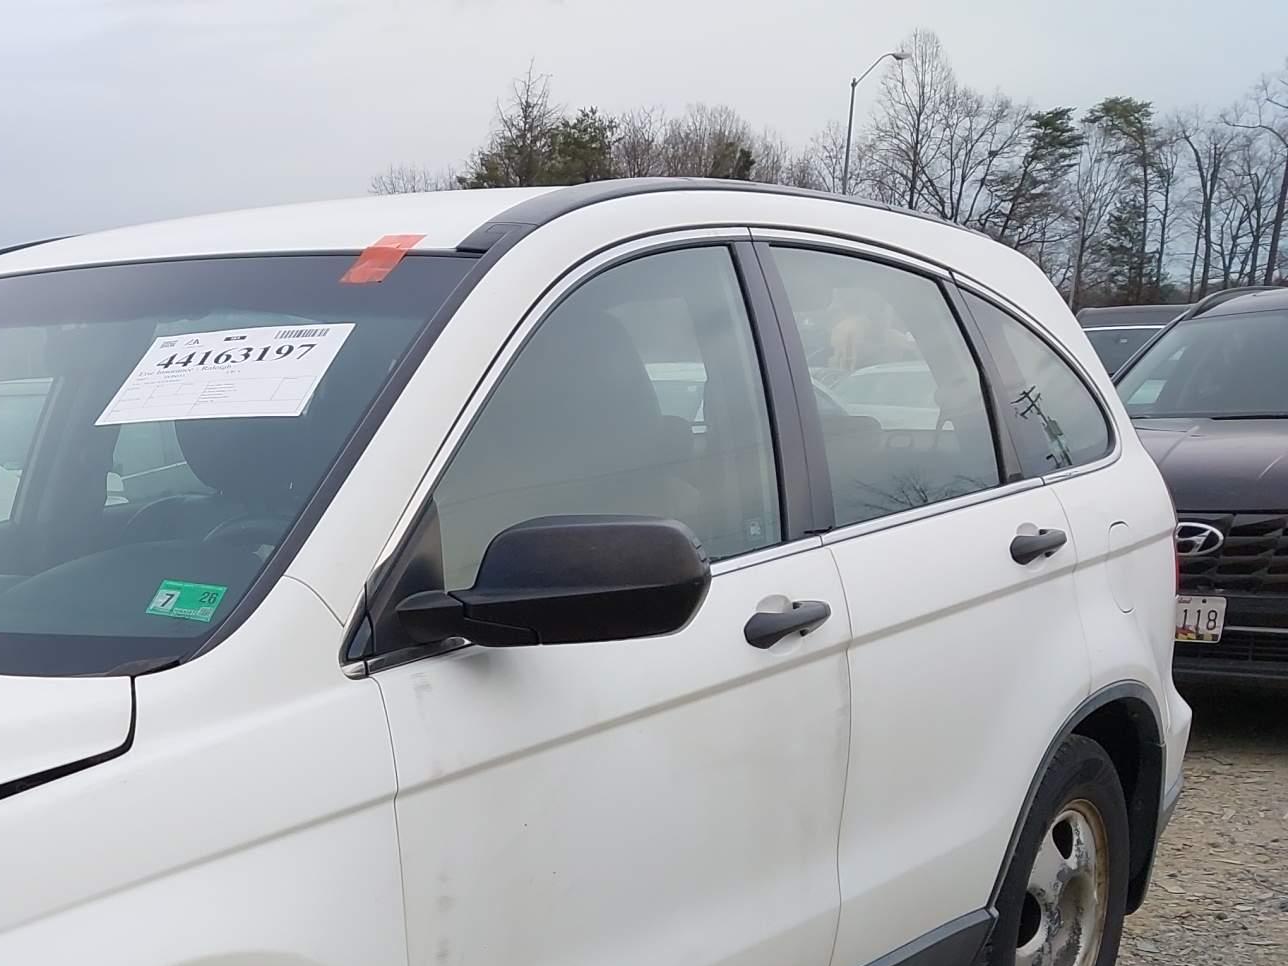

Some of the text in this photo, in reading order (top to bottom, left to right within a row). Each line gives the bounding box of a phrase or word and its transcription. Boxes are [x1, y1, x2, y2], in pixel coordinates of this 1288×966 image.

[156, 343, 317, 369] 44163197
[160, 591, 219, 607] 7 26
